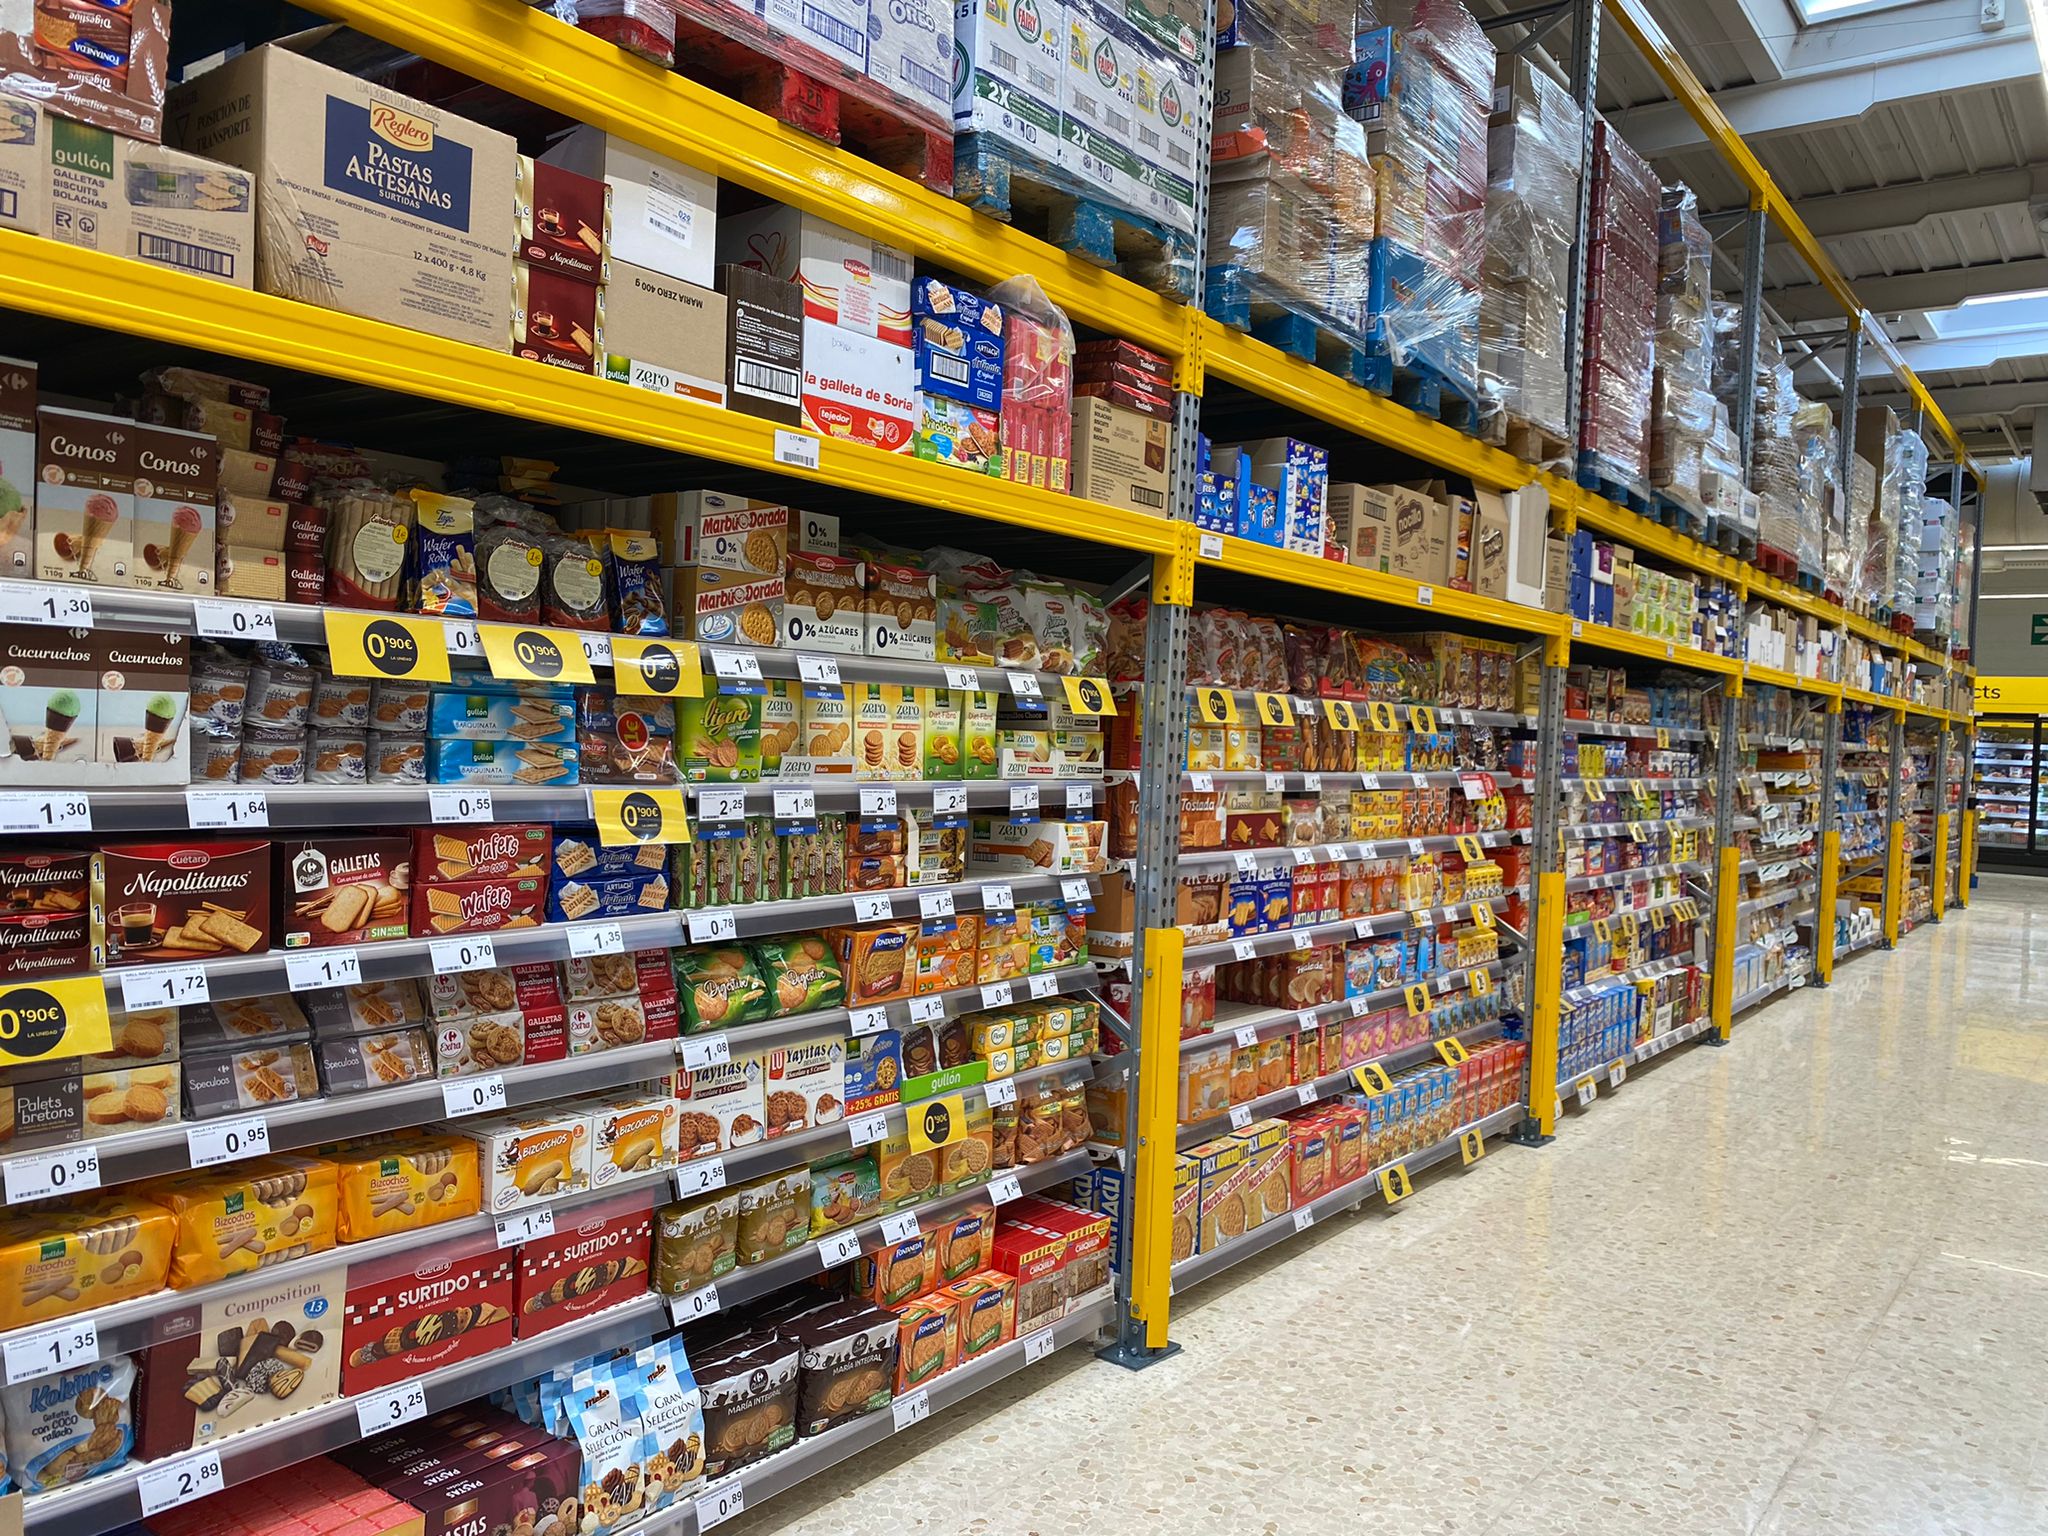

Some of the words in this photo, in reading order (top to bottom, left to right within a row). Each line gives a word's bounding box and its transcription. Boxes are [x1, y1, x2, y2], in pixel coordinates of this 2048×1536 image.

[1098, 57, 1115, 80] FAIRY
[64, 92, 109, 113] Digestive
[1162, 97, 1179, 118] FAIRY
[373, 107, 429, 142] Reglero
[55, 149, 111, 174] gullón
[367, 141, 432, 185] PASTAS
[53, 168, 105, 188] GALLETAS
[53, 178, 98, 196] BISCUITS
[345, 155, 452, 210] ARTESANAS
[53, 189, 107, 209] BOLACHAS
[379, 189, 420, 210] SURTIDAS
[414, 251, 423, 261] 12
[424, 254, 430, 264] x
[431, 256, 448, 269] 400
[449, 261, 455, 272] g
[475, 269, 486, 281] Kg
[642, 282, 656, 293] 400
[658, 286, 677, 301] ZERO
[676, 292, 703, 308] MARIA
[804, 371, 816, 384] la
[820, 375, 862, 400] galleta
[865, 389, 880, 402] de
[883, 392, 913, 412] Soria
[820, 409, 850, 425] tejedor
[50, 435, 117, 463] Conos
[140, 451, 200, 476] Conos
[292, 520, 326, 533] Galletas
[297, 531, 320, 542] corte
[291, 570, 324, 583] Galletas
[620, 566, 645, 578] Wafer
[298, 579, 321, 590] corte
[699, 587, 737, 612] Marbú
[746, 580, 784, 600] Dorada
[43, 598, 90, 619] 1,30
[233, 613, 273, 632] 0,24
[899, 634, 932, 644] AZÚCARES
[8, 645, 91, 662] Cucuruchos
[109, 650, 183, 666] Cucuruchos
[735, 657, 757, 673] 1,99
[818, 664, 838, 678] 1,99
[784, 761, 811, 773] zero
[40, 802, 87, 824] 1,30
[227, 801, 266, 821] 1,64
[459, 798, 490, 817] 0,55
[720, 800, 742, 815] 2,25
[793, 799, 813, 812] 1,80
[877, 797, 895, 810] 2,15
[1181, 798, 1215, 812] Tostada
[998, 823, 1028, 836] zero
[171, 853, 207, 865] Cuétara
[466, 833, 519, 866] Wafers
[330, 853, 381, 874] GALLETAS
[124, 870, 248, 898] Napolitanas
[607, 882, 632, 890] ARTIACH
[460, 885, 511, 920] Wafers
[871, 902, 890, 915] 2,50
[371, 927, 386, 937] SIN
[711, 919, 734, 935] 0,78
[594, 931, 621, 950] 1,35
[875, 935, 904, 947] FONTANEDA
[8, 955, 76, 971] Napolitanas
[461, 945, 491, 965] 0,70
[321, 959, 356, 981] 1,17
[162, 976, 205, 1000] 1,72
[868, 1011, 886, 1027] 2,75
[528, 1028, 563, 1039] cacahuetes
[440, 1039, 462, 1052] Extra
[704, 1041, 728, 1061] 1,08
[786, 1042, 826, 1064] Yayitas
[324, 1058, 360, 1071] Speculoos
[771, 1051, 784, 1069] LU
[189, 1077, 231, 1091] Speculoos
[677, 1071, 690, 1088] LU
[931, 1072, 961, 1092] gullón
[473, 1084, 504, 1106] 0,95
[850, 1097, 872, 1111] +25%
[874, 1092, 899, 1105] GRATIS
[18, 1097, 62, 1113] Palets
[22, 1107, 74, 1125] bretons
[619, 1114, 659, 1136] BIZCOCHOS
[867, 1121, 886, 1138] 1,25
[225, 1128, 265, 1153] 0,95
[522, 1135, 567, 1157] BIZCOCHOS
[50, 1158, 97, 1187] 0,95
[370, 1175, 409, 1189] Bizcochos
[700, 1166, 724, 1188] 2,55
[214, 1212, 255, 1227] Bizcochos
[523, 1213, 551, 1235] 1,45
[563, 1232, 619, 1262] SURTIDO
[839, 1238, 858, 1257] 0,85
[225, 1281, 321, 1318] Composition
[398, 1276, 470, 1309] SURTIDO
[694, 1290, 717, 1312] 0,98
[309, 1301, 323, 1312] 13
[49, 1332, 94, 1364] 1,35
[833, 1363, 855, 1375] MARÍA
[855, 1354, 882, 1368] INTEGRAL
[30, 1364, 113, 1414] Kokinos
[389, 1391, 423, 1419] 3,25
[654, 1392, 682, 1408] GRAN
[646, 1399, 696, 1428] SELECCIÓN
[32, 1425, 49, 1437] con
[52, 1414, 78, 1429] COCO
[42, 1427, 73, 1443] rallado
[588, 1419, 619, 1438] GRAN
[584, 1428, 632, 1457] SELECCIÓN
[177, 1463, 219, 1497] 2,89
[719, 1491, 742, 1515] 0,89
